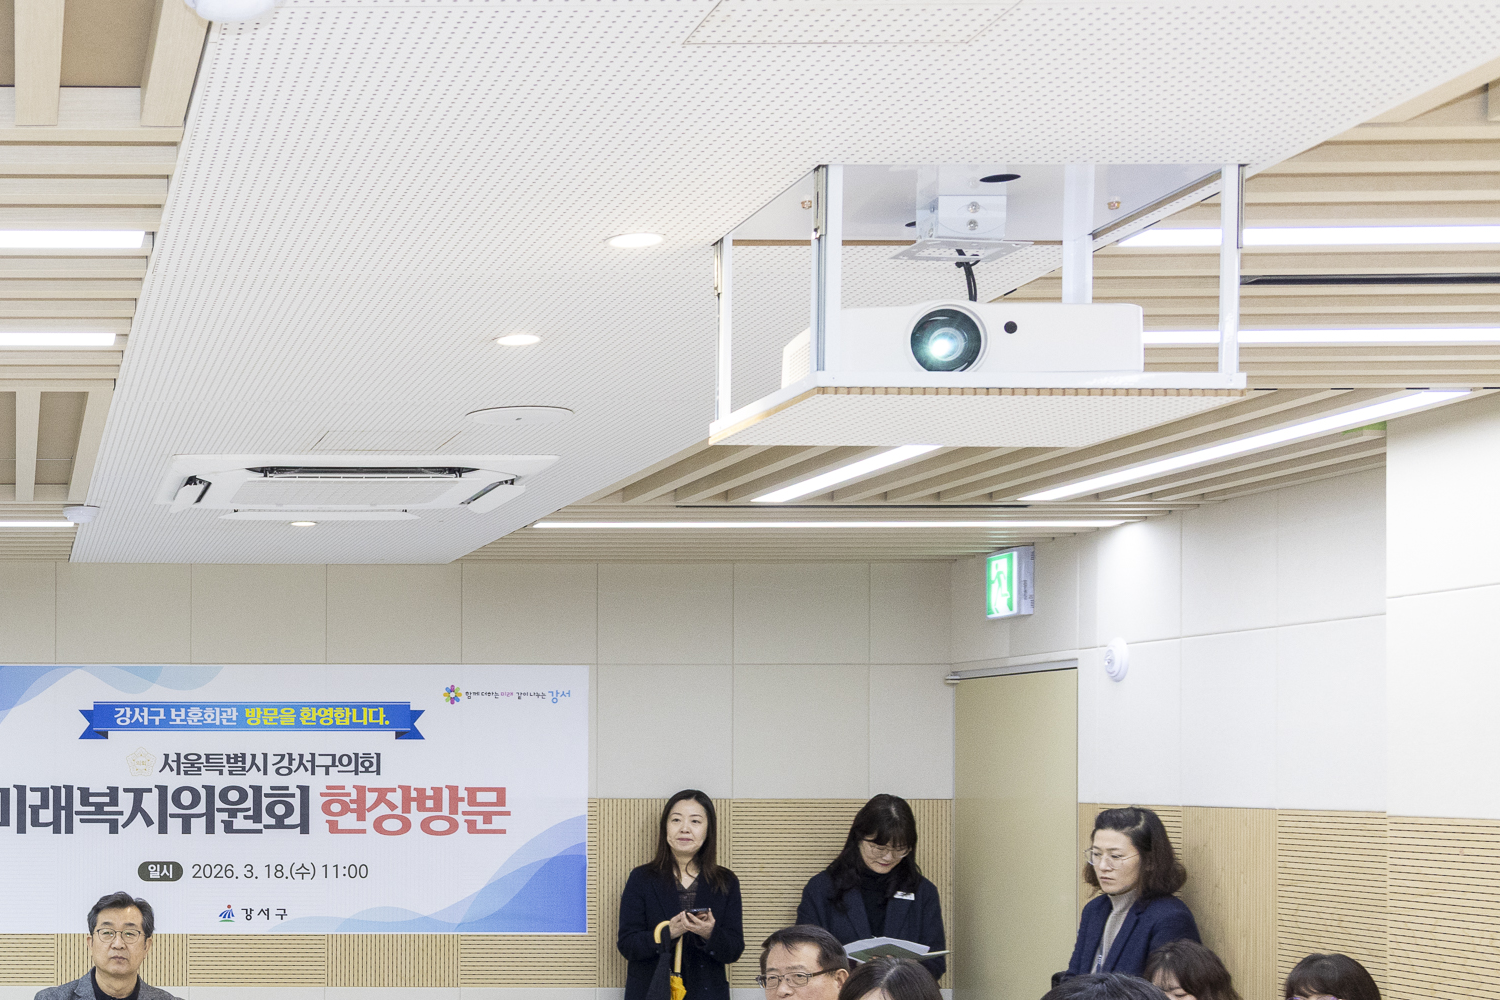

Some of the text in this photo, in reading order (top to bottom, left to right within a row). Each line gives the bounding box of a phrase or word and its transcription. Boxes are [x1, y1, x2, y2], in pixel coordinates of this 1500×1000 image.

[548, 690, 571, 704] 강서
[114, 707, 390, 726] 강서구 보훈회관 방문을 환영합니다.
[158, 752, 382, 776] 서울특별시 강서구의회
[319, 784, 512, 836] 현장방문
[147, 864, 173, 879] 일시
[191, 863, 239, 880] 2026.
[243, 863, 259, 880] 3.
[321, 863, 369, 879] 11:00
[241, 907, 288, 921] 강서구
